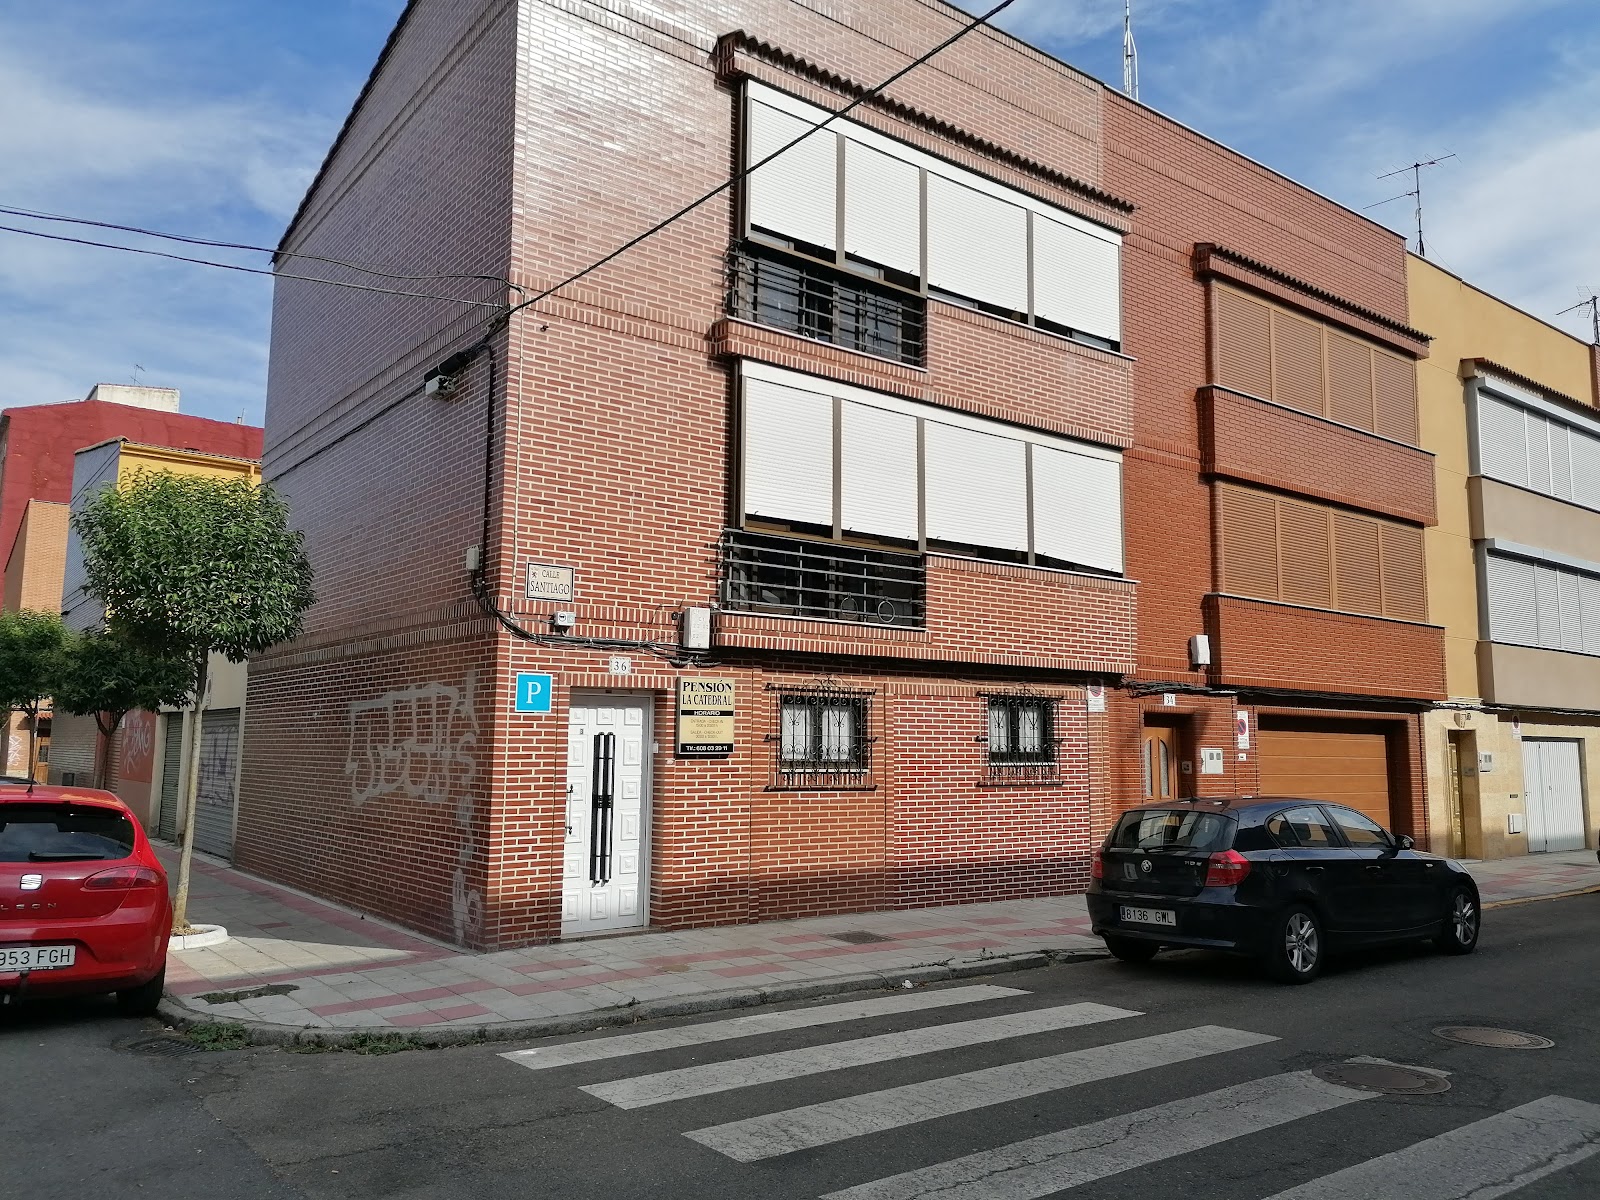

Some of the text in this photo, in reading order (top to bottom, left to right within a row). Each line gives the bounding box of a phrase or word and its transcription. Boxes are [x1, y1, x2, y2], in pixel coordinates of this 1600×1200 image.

[542, 570, 560, 579] CALLE
[530, 581, 570, 595] SANTIAGO
[614, 661, 627, 671] 36
[526, 681, 542, 704] P
[683, 680, 732, 693] PENSIÓN
[682, 694, 732, 706] LA CATEDRAL
[1126, 909, 1173, 924] 8136 GWL
[37, 949, 71, 964] FGH
